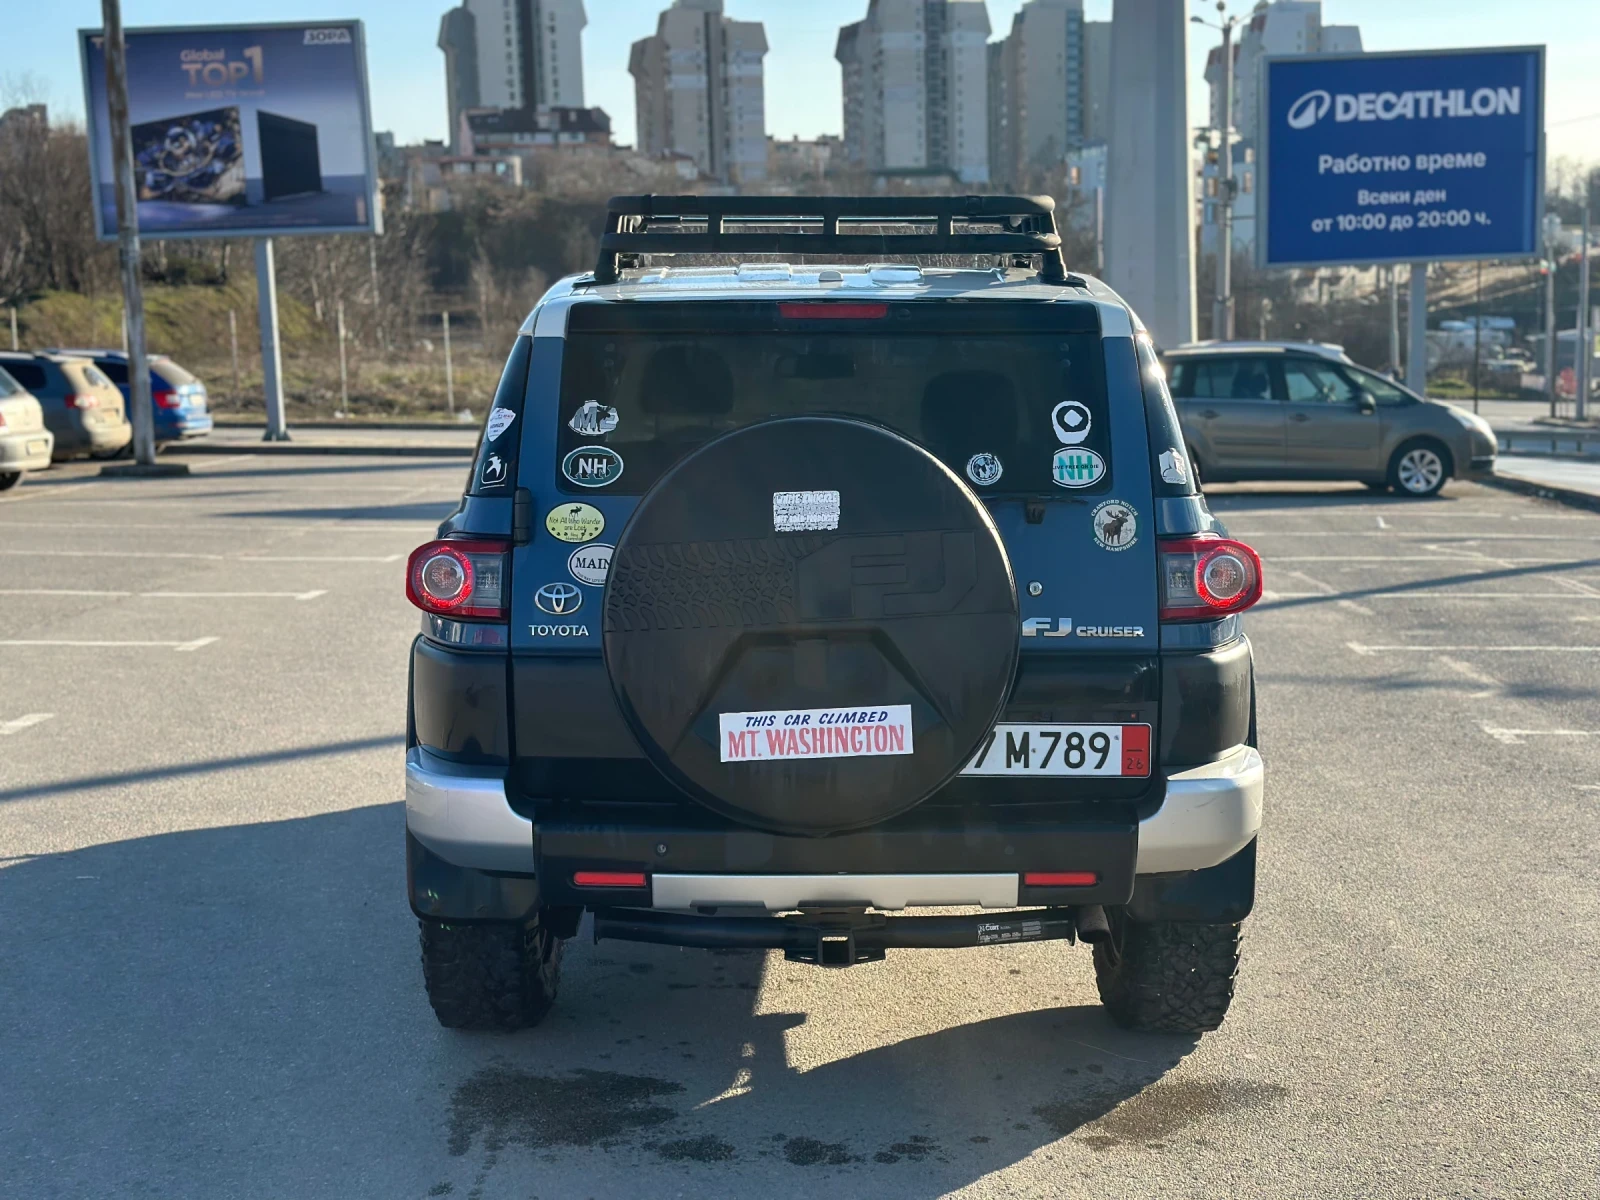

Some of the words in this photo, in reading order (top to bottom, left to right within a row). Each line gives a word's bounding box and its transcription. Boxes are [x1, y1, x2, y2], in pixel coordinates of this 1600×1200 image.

[180, 49, 225, 61] Global
[1335, 87, 1520, 122] DECATHLON
[1318, 153, 1411, 175] Работно
[1415, 151, 1487, 174] време
[1357, 189, 1410, 206] Всеки
[1413, 189, 1447, 205] ден
[1311, 217, 1333, 233] от
[1336, 214, 1386, 231] 10:00
[1389, 216, 1413, 232] до
[1417, 210, 1471, 227] 20:00
[1474, 211, 1491, 226] ч.
[578, 457, 608, 474] NH
[1057, 454, 1094, 481] NH
[1091, 499, 1120, 517] CRAWFORD
[1120, 500, 1139, 517] NOTCH
[1093, 537, 1106, 548] NEW
[1105, 537, 1139, 552] HAMPSHIRE
[528, 624, 589, 637] TOYOTA
[1022, 616, 1073, 638] FJ
[1076, 625, 1145, 638] CRUISER
[745, 715, 777, 728] THIS
[784, 713, 811, 726] CAR
[818, 710, 889, 724] CLIMBED
[727, 730, 763, 759] MT.
[765, 724, 905, 757] WASHINGTON
